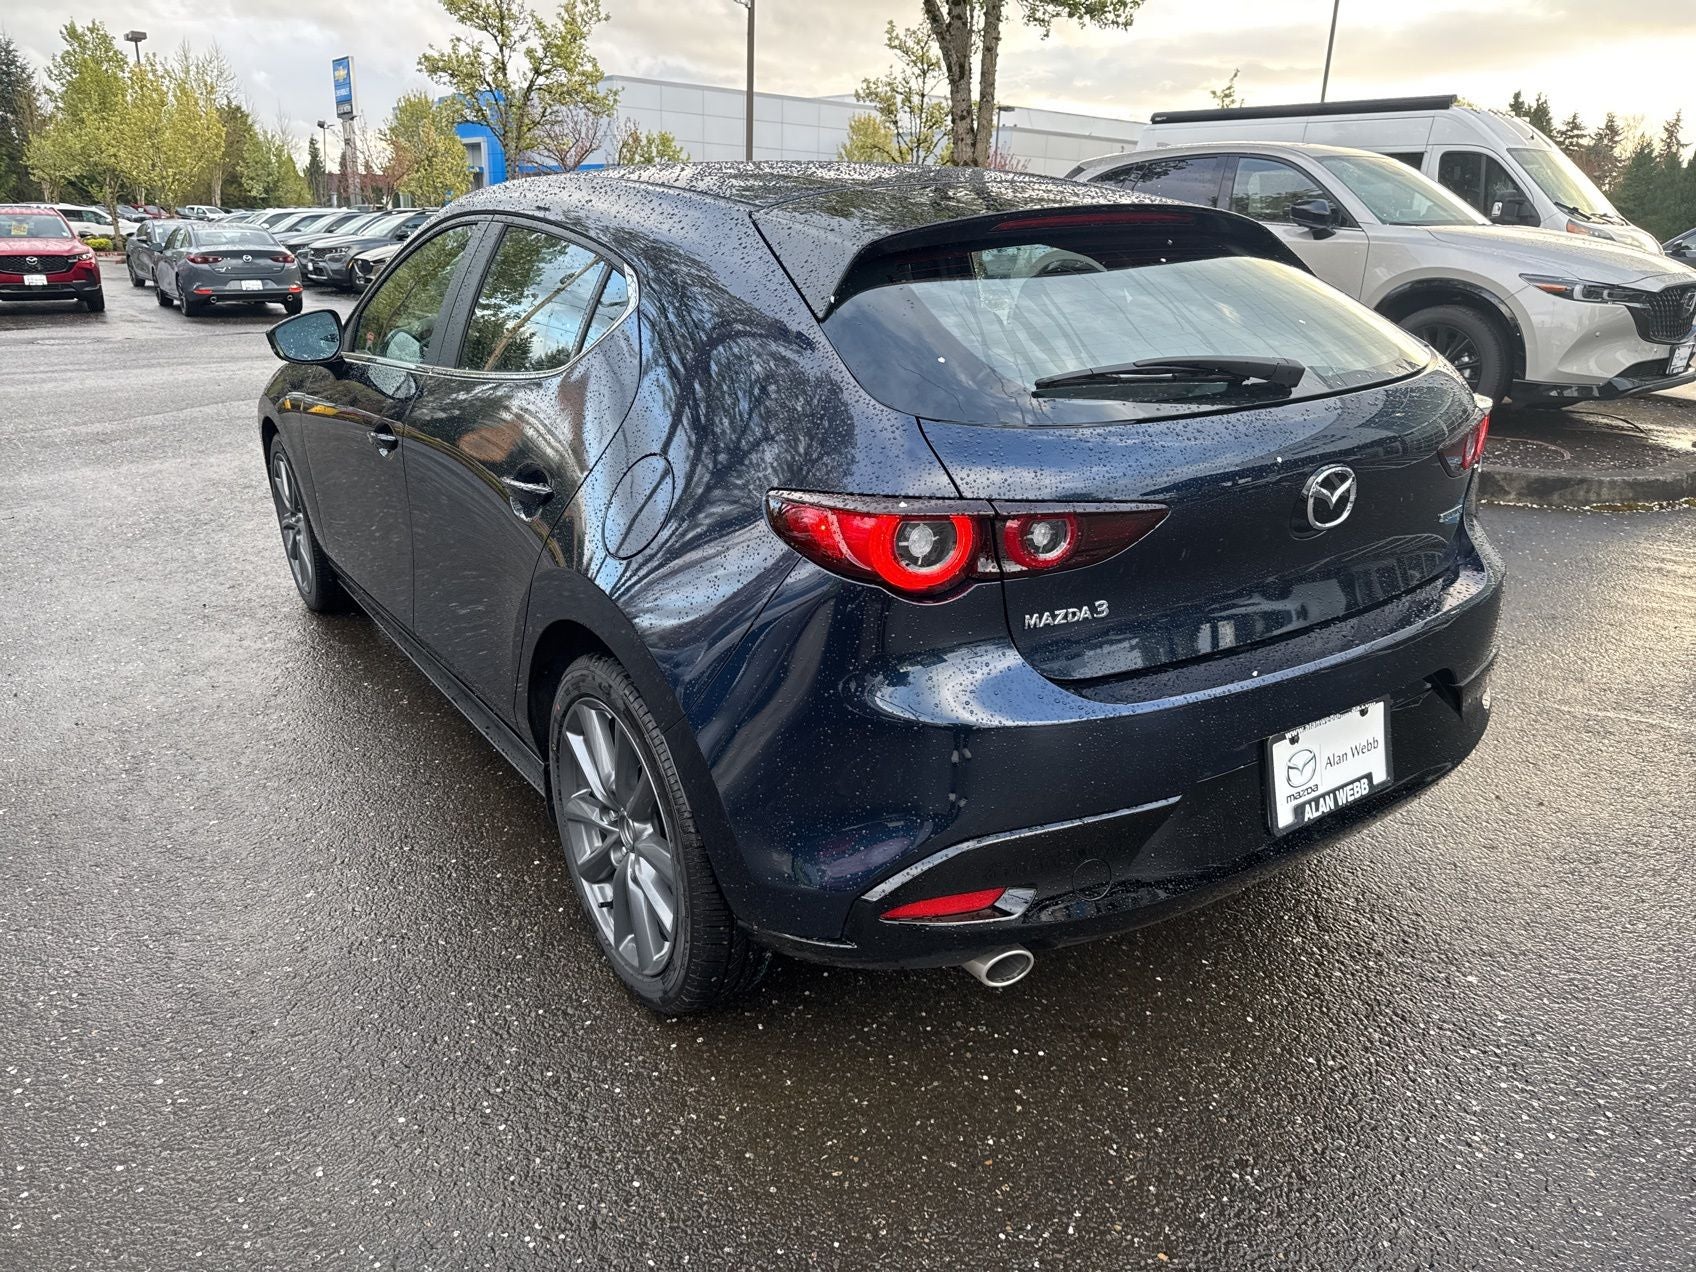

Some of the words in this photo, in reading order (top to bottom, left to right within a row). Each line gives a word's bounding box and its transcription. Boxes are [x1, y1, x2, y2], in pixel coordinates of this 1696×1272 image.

[1324, 750, 1348, 770] Alan
[1350, 737, 1379, 759] Webb
[1304, 793, 1335, 822] ALAN
[1336, 778, 1370, 806] WEBB
